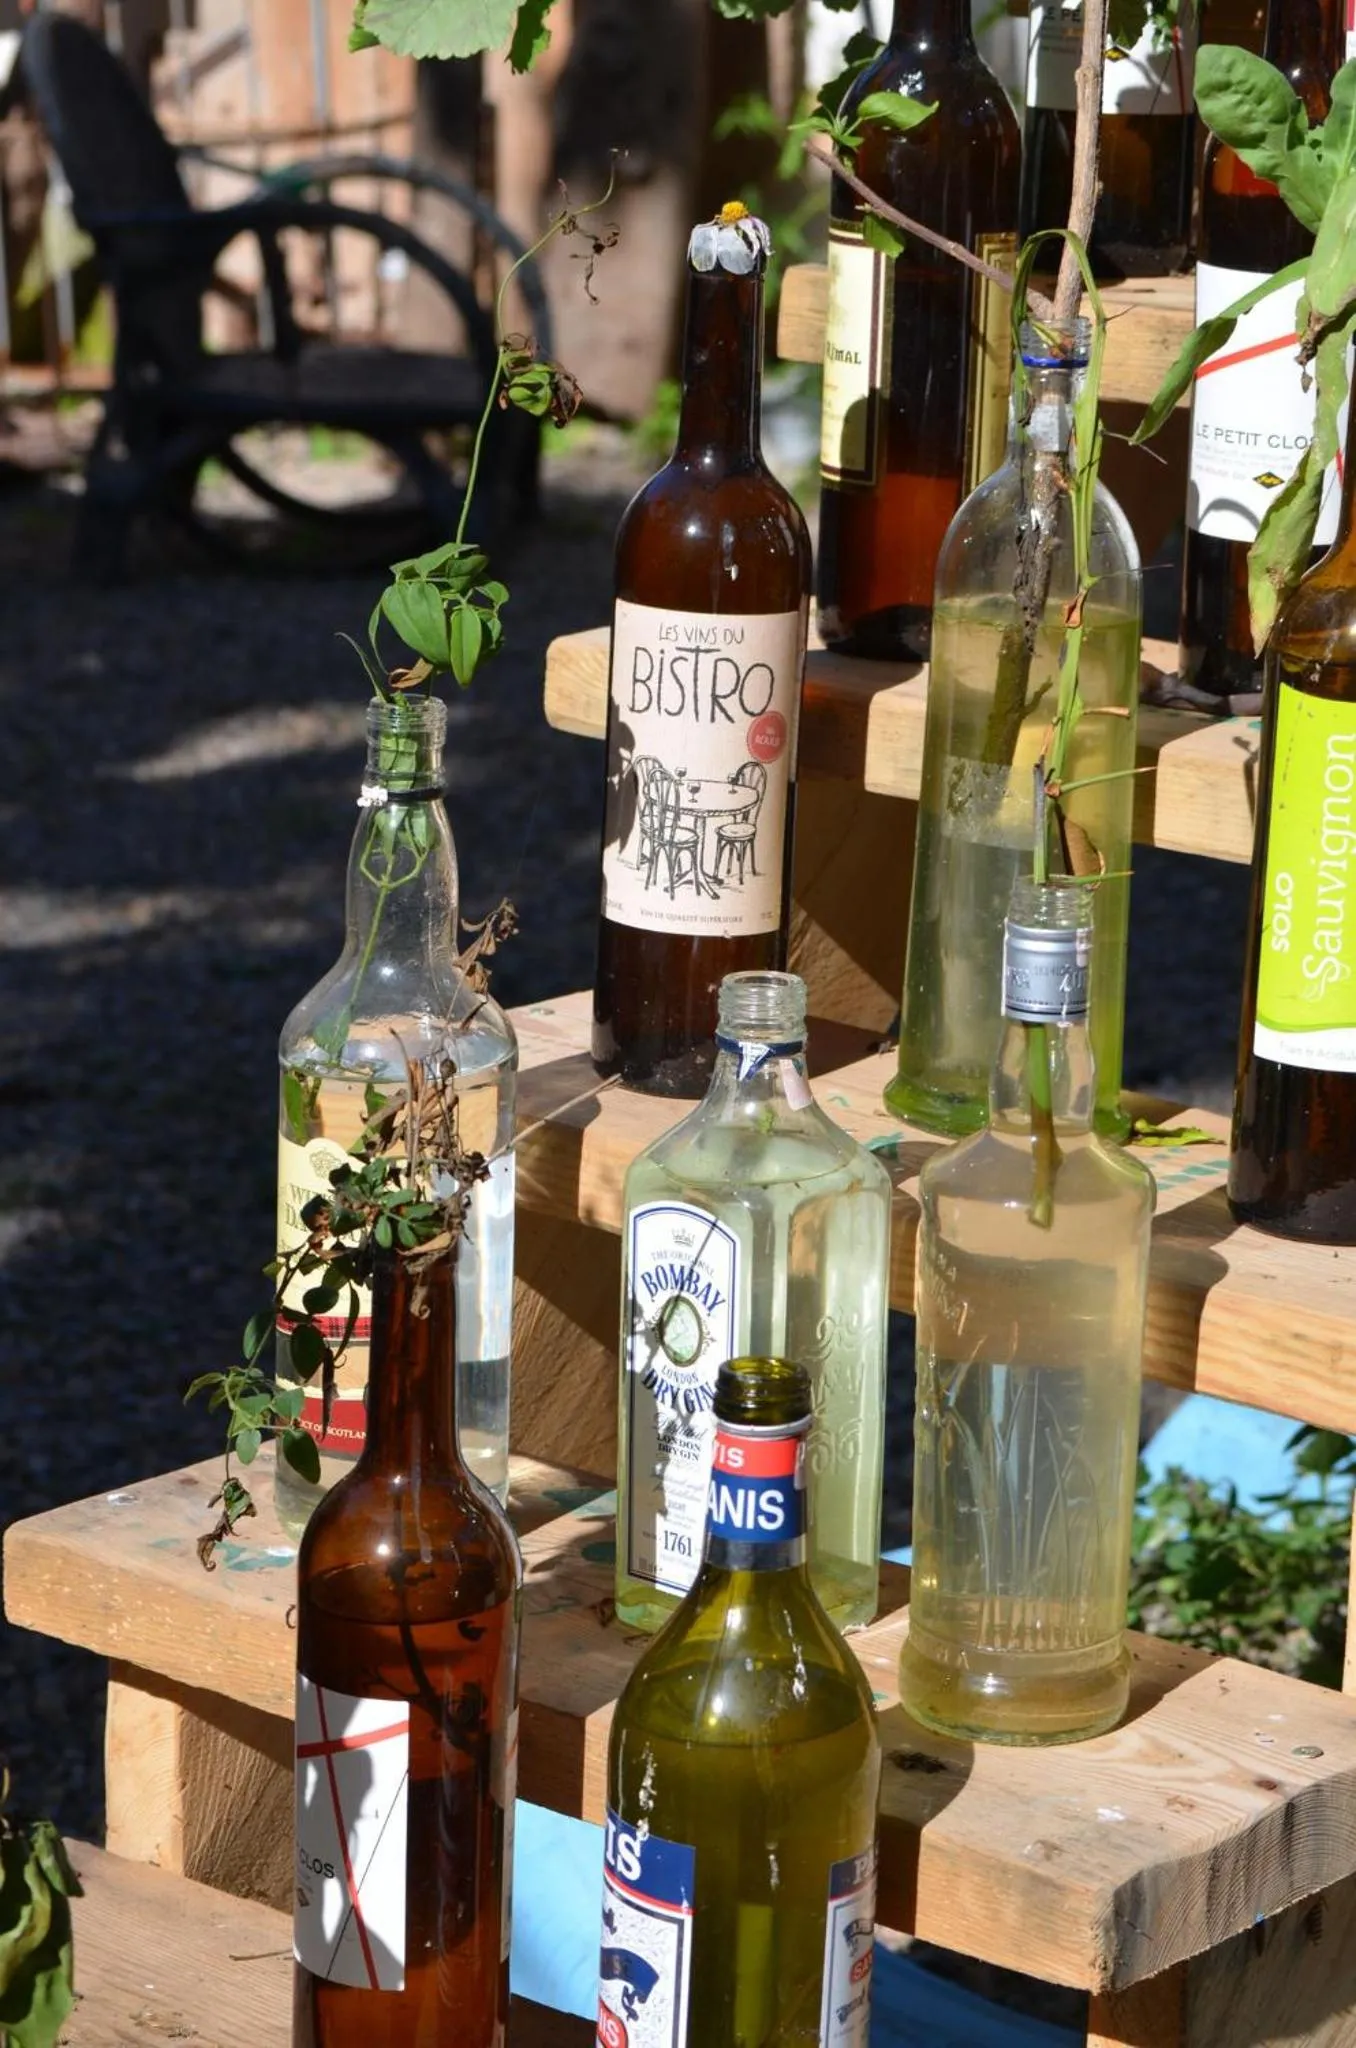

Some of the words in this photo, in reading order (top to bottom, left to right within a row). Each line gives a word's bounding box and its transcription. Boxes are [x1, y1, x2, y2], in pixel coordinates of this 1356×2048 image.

[1196, 422, 1210, 439] LE
[1214, 427, 1262, 447] PETIT
[658, 622, 679, 642] LES
[684, 624, 718, 645] VINS
[723, 627, 745, 645] DU
[1301, 732, 1356, 986] Sauvignon
[1271, 871, 1294, 954] SOLO
[640, 1263, 726, 1313] BOMBAY
[641, 1368, 680, 1409] DRY
[683, 1380, 717, 1414] GIN
[661, 1364, 699, 1385] LONDON
[708, 1480, 785, 1531] ANIS
[663, 1529, 693, 1558] 1761
